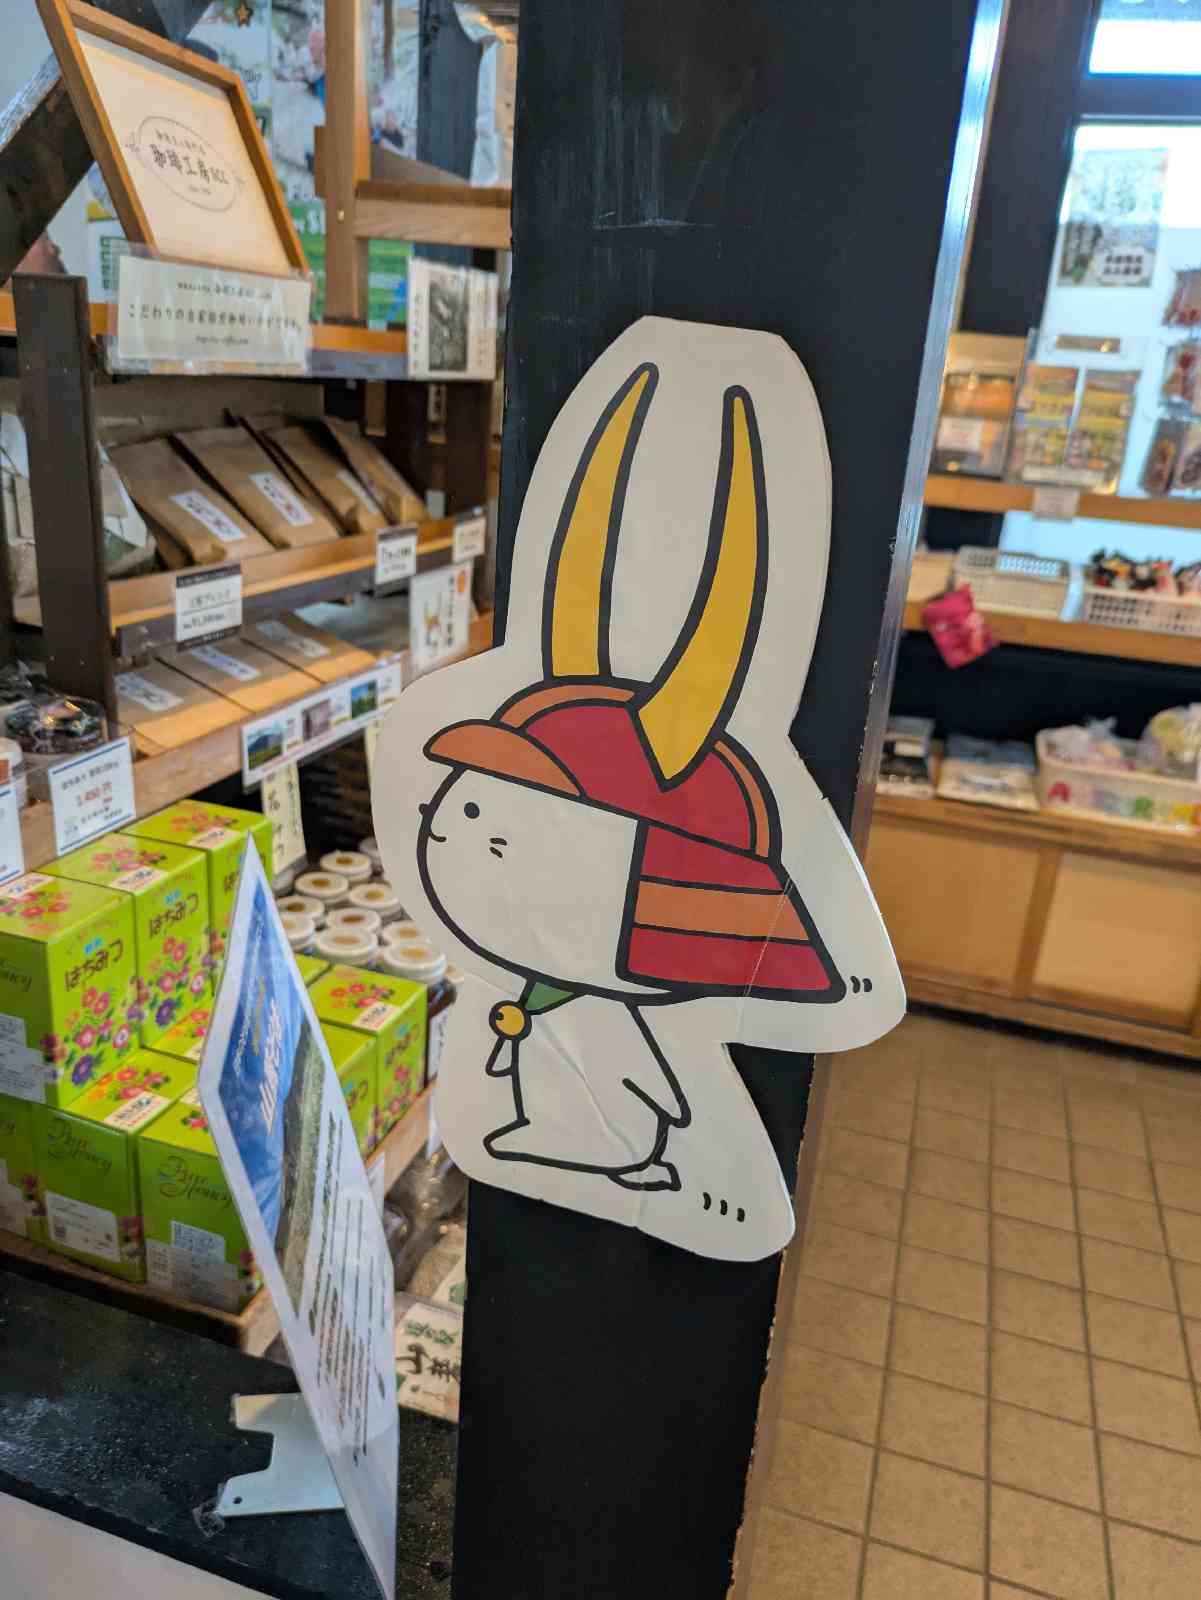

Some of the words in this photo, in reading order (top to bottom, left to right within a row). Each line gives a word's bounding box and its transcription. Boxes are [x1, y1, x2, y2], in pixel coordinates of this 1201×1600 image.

[150, 893, 199, 938] はちみつ
[65, 938, 124, 992] はちみつ
